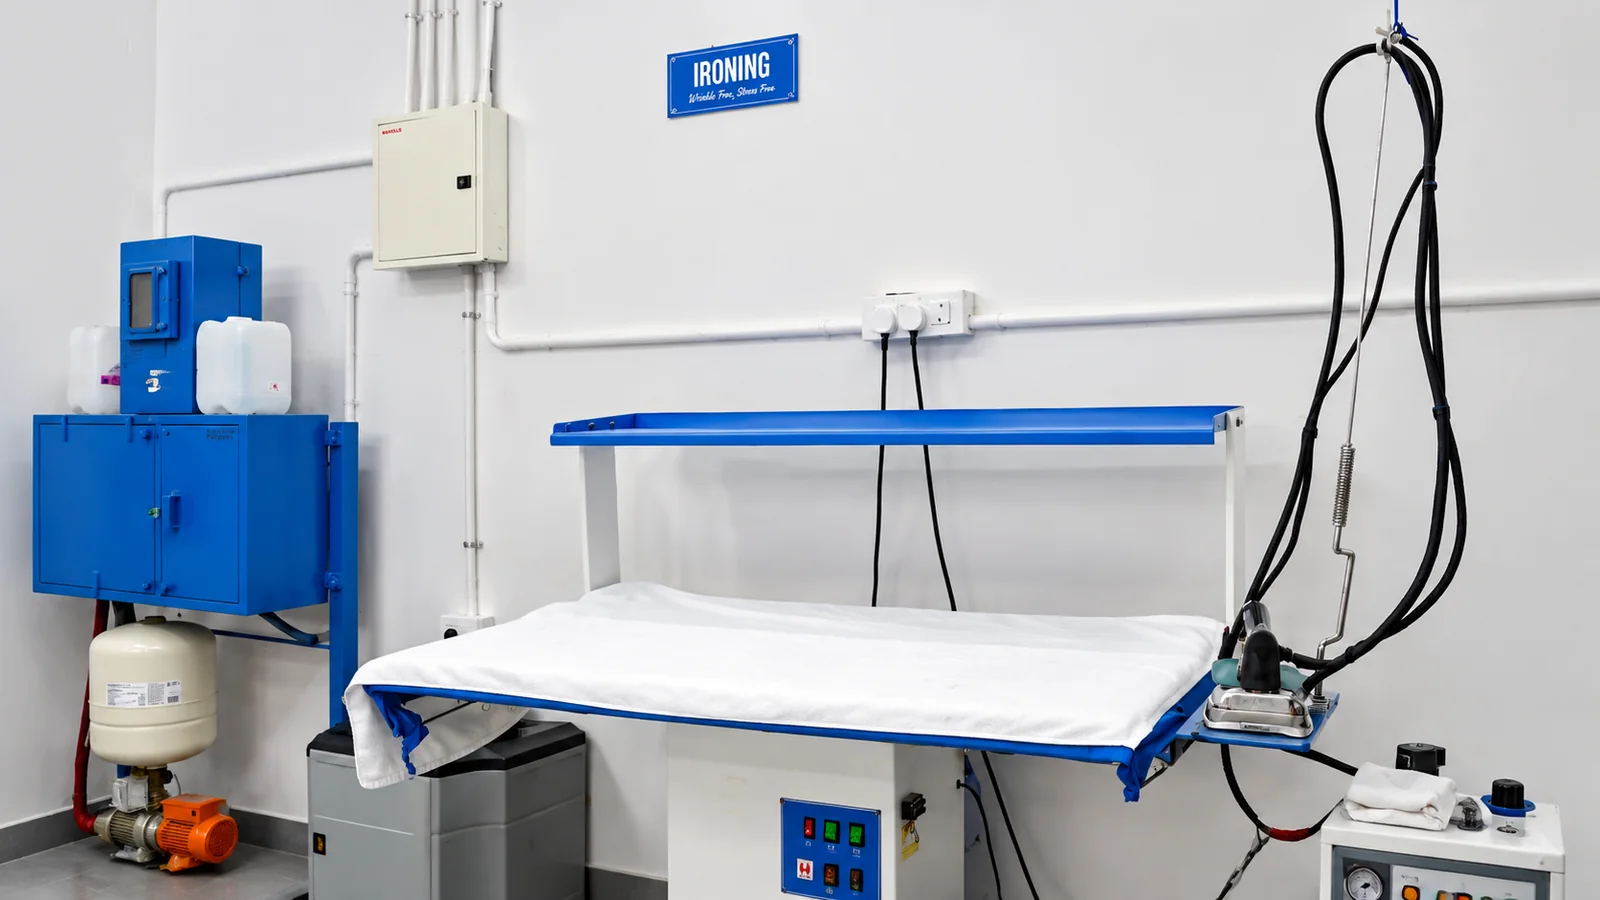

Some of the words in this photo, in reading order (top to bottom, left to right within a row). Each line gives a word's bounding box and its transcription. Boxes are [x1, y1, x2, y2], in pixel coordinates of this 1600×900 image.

[694, 52, 770, 87] IRONING
[688, 91, 716, 103] Wrinkle
[718, 90, 735, 100] Free,
[737, 87, 758, 96] Stress
[760, 83, 775, 93] Free
